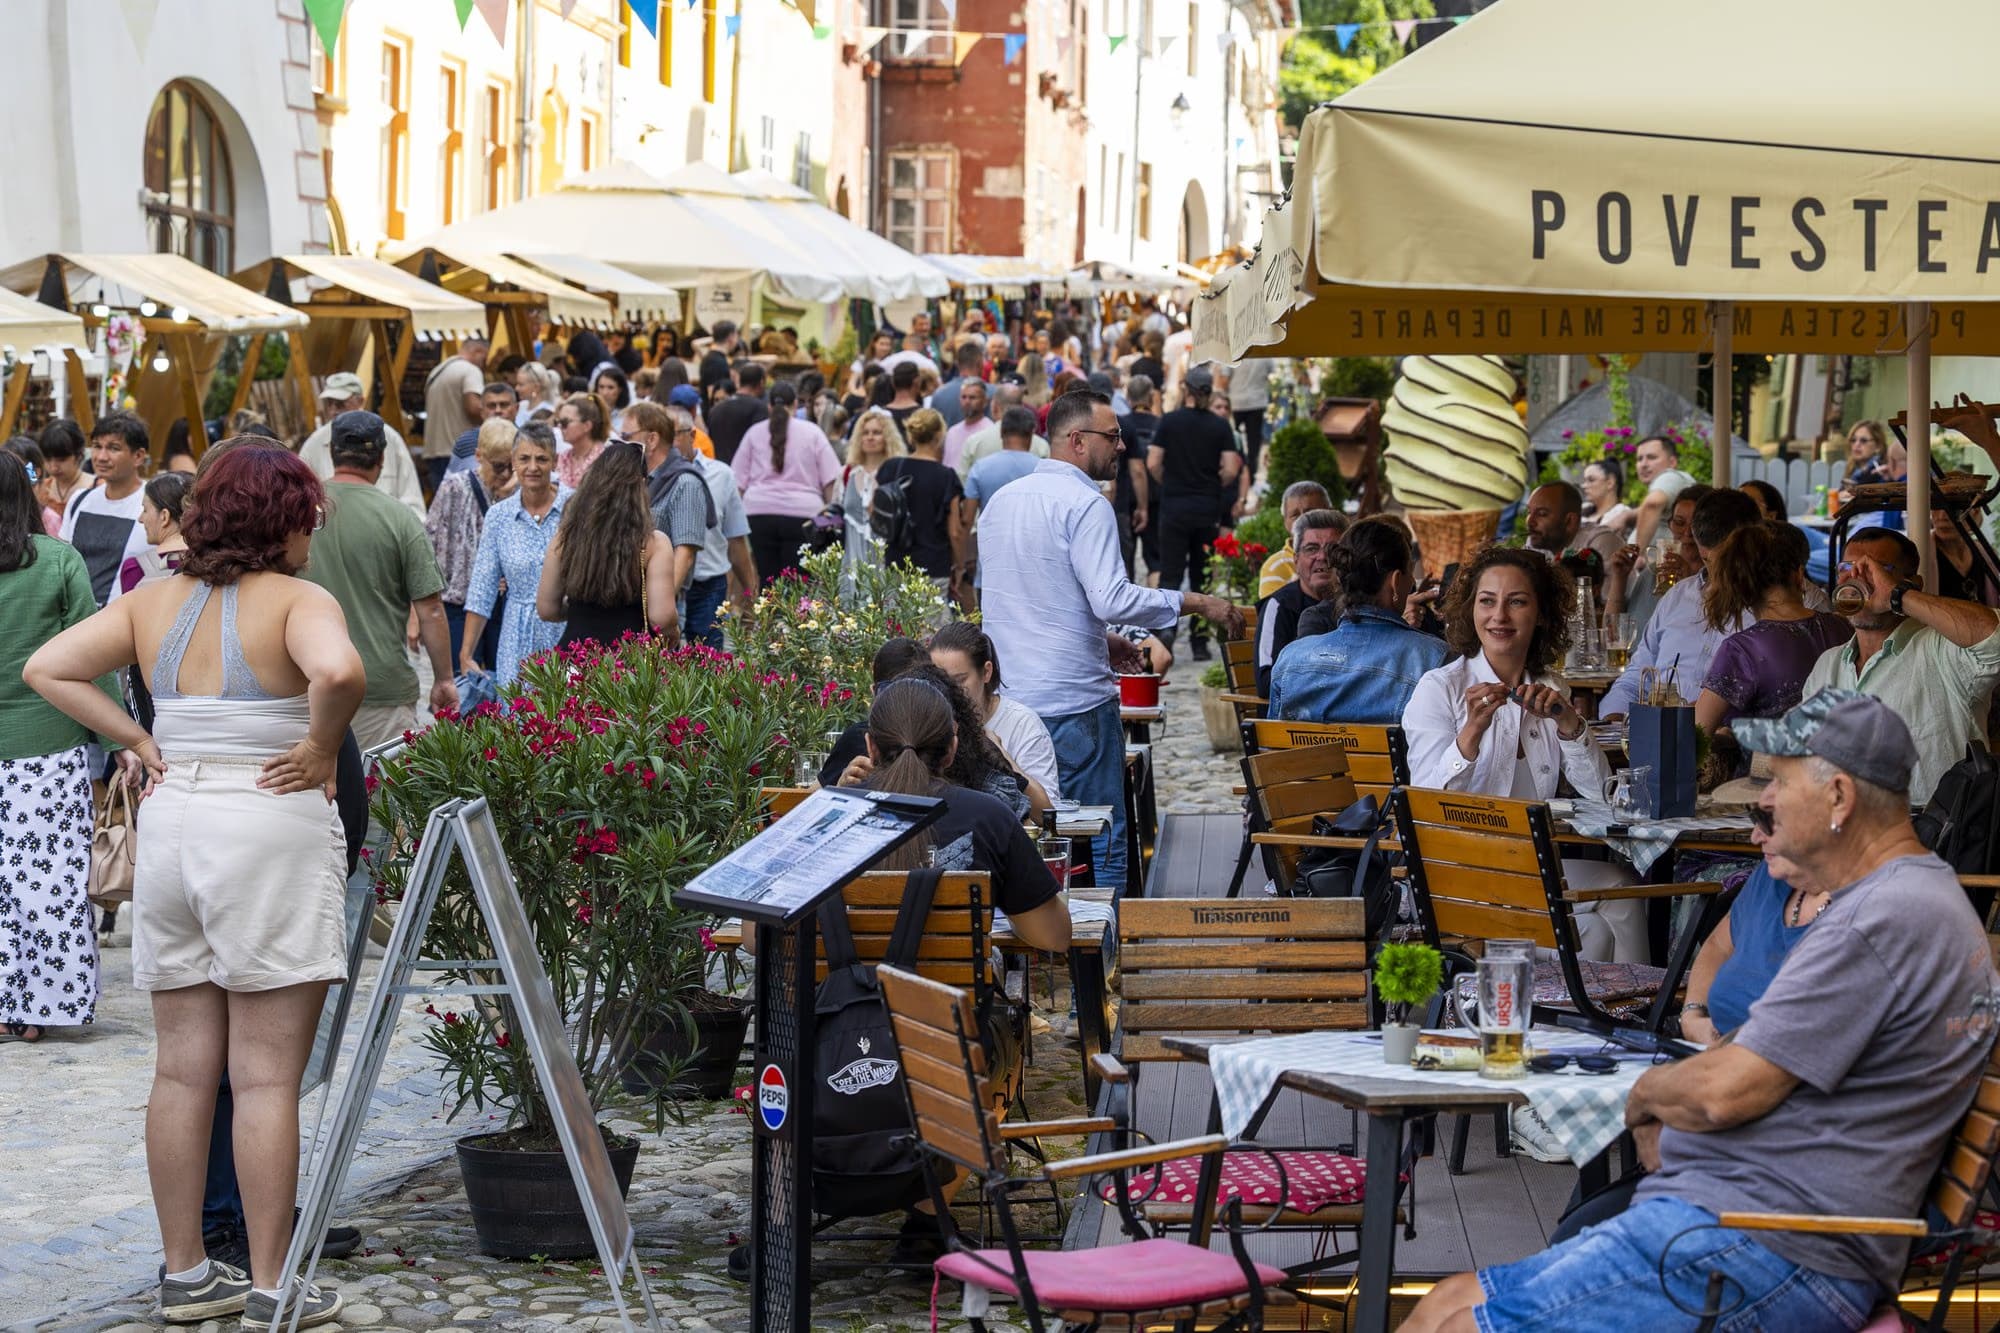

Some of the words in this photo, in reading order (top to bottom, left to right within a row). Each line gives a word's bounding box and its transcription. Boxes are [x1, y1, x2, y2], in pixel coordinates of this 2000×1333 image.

[1531, 190, 2000, 273] POVESTEA
[1497, 983, 1512, 1027] URSUS
[850, 1061, 872, 1077] VANS
[855, 1071, 873, 1084] THE
[761, 1087, 785, 1106] PEPSI
